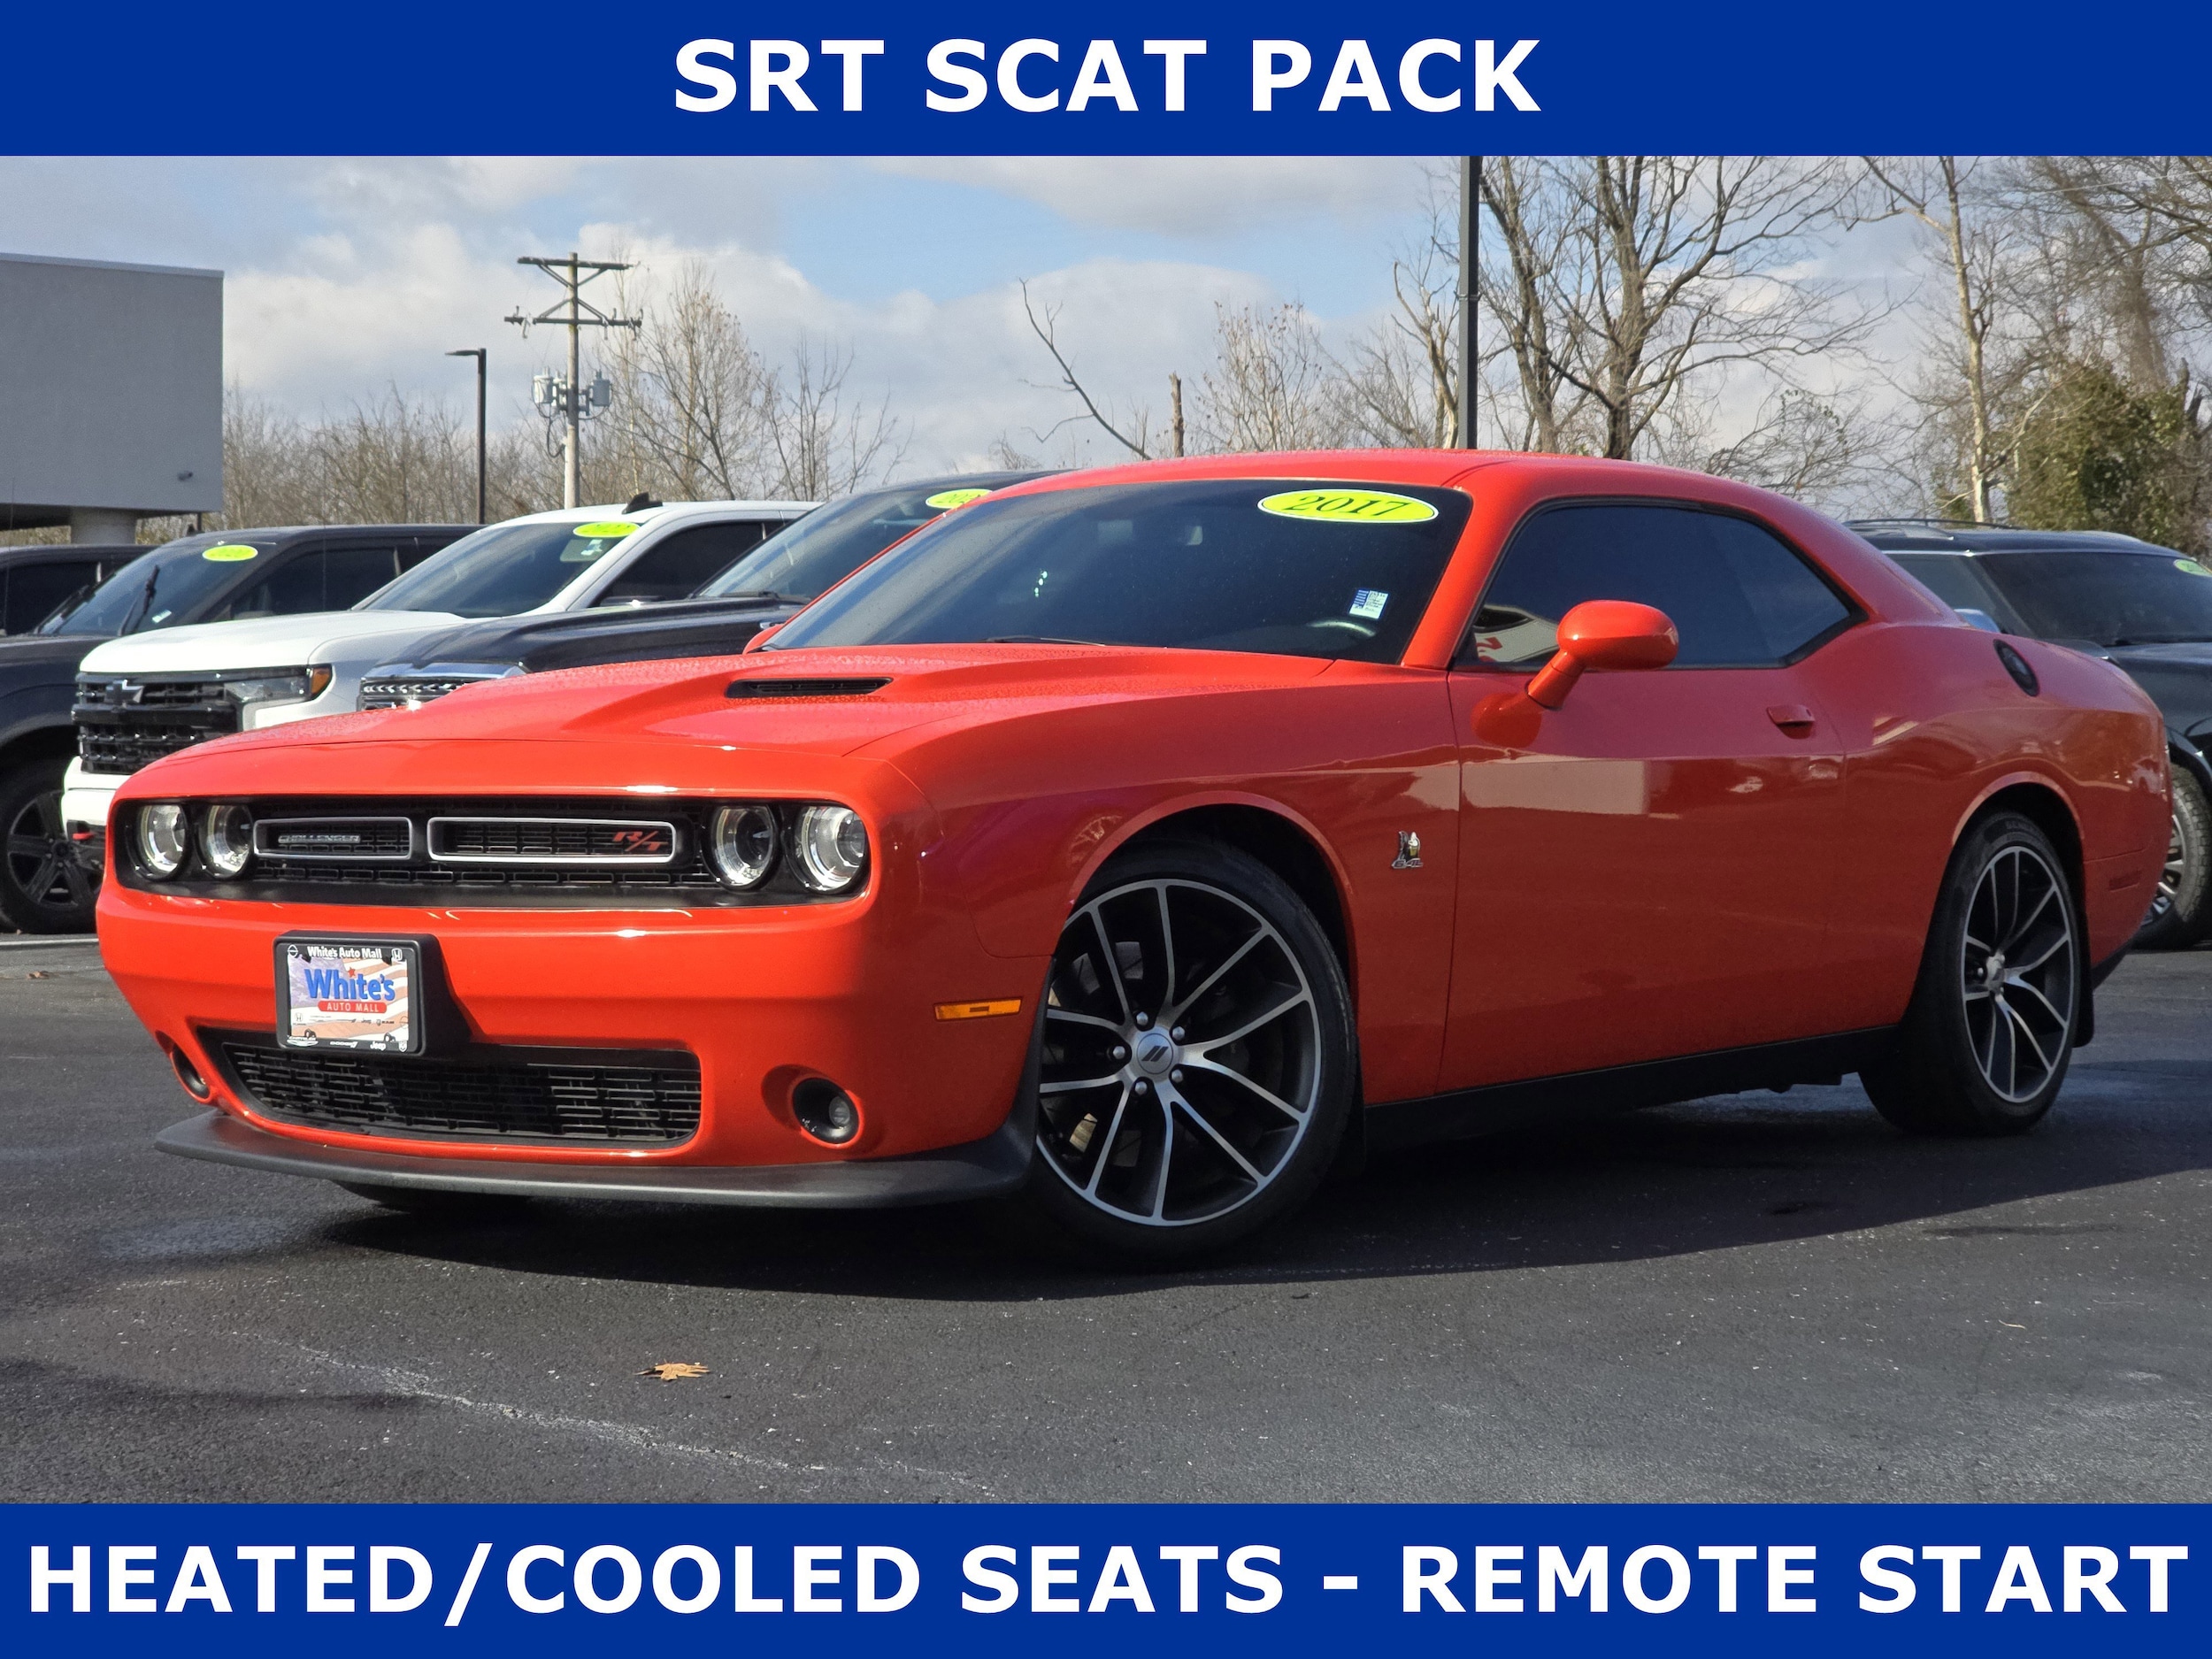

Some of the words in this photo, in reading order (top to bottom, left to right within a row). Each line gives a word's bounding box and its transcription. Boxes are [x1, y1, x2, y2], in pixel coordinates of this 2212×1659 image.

[1281, 495, 1409, 517] 2017
[277, 834, 361, 844] CHALLENGER
[611, 831, 669, 851] R/T
[306, 945, 338, 958] White's
[339, 947, 361, 958] Auto
[361, 948, 383, 959] Mall
[303, 968, 396, 1002] White's
[326, 1002, 351, 1011] AUTO
[356, 1002, 380, 1013] MALL
